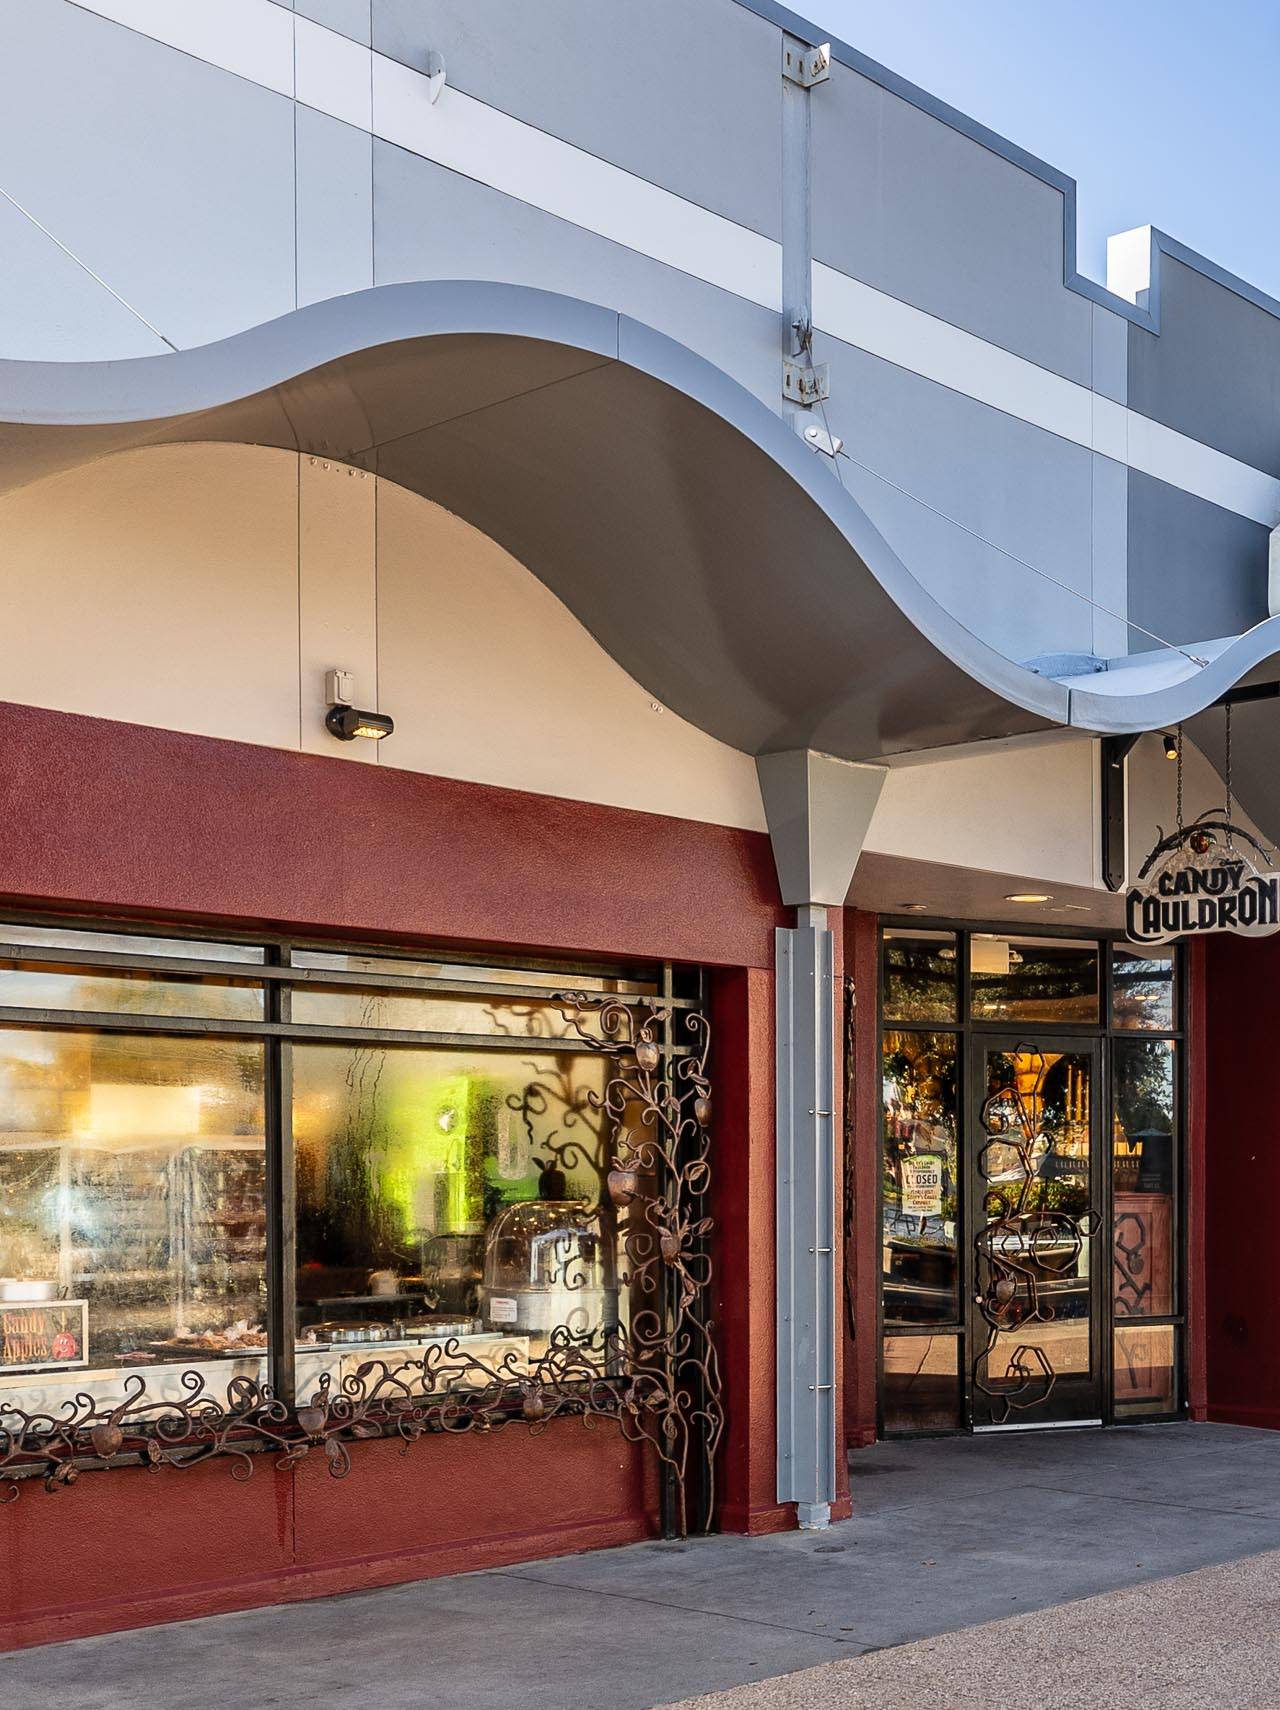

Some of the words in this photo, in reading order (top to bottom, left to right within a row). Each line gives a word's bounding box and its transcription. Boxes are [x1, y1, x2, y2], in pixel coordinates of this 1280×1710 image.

[1158, 865, 1246, 897] CANDY
[1126, 876, 1279, 942] CAULDRON
[3, 1310, 45, 1336] Candy
[3, 1333, 48, 1362] Apples
